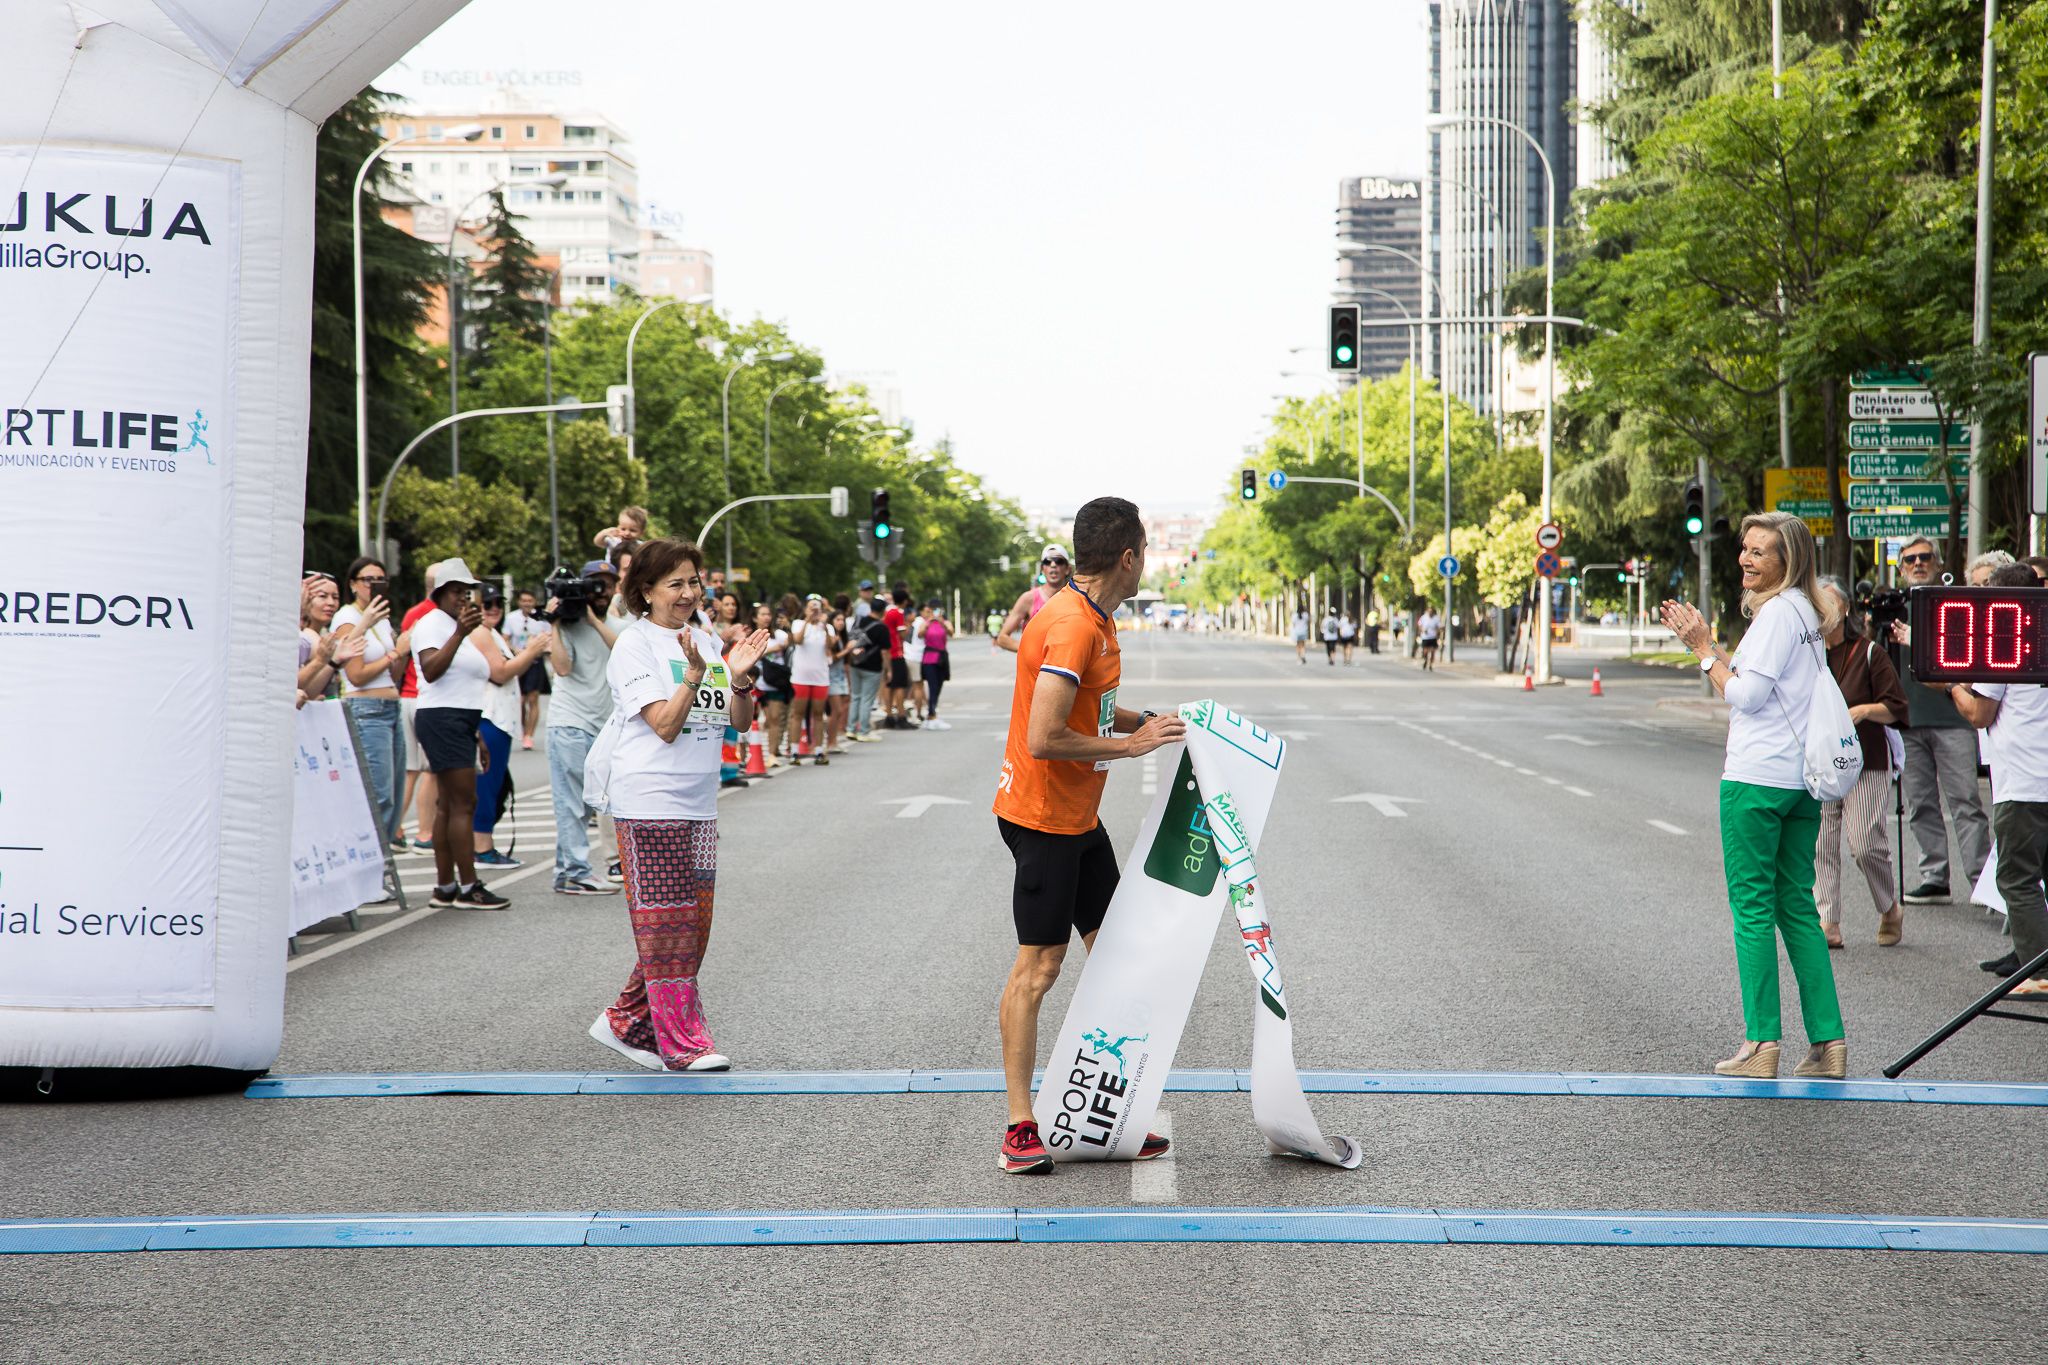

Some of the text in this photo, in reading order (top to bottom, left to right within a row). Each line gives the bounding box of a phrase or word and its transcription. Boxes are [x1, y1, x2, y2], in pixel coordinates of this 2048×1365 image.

[1360, 177, 1418, 199] BBVA
[1855, 395, 1916, 405] Ministerio
[1855, 406, 1904, 415] Defensa
[1853, 424, 1891, 433] calle de
[1853, 432, 1934, 446] San Germán
[99, 457, 107, 468] Y
[112, 457, 176, 472] EVENTOS
[1853, 455, 1897, 465] calle de
[1854, 464, 1899, 475] Alberto
[1853, 485, 1900, 495] calle del
[1853, 496, 1887, 506] Padre
[1853, 516, 1911, 526] plaza de la
[1867, 525, 1938, 536] Dominicana
[57, 904, 204, 936] Services
[1116, 1088, 1137, 1135] COMUNICACIÓN
[1135, 1052, 1149, 1082] EVENTOS
[1048, 1048, 1100, 1151] SPORT
[1080, 1071, 1128, 1147] LIFE
